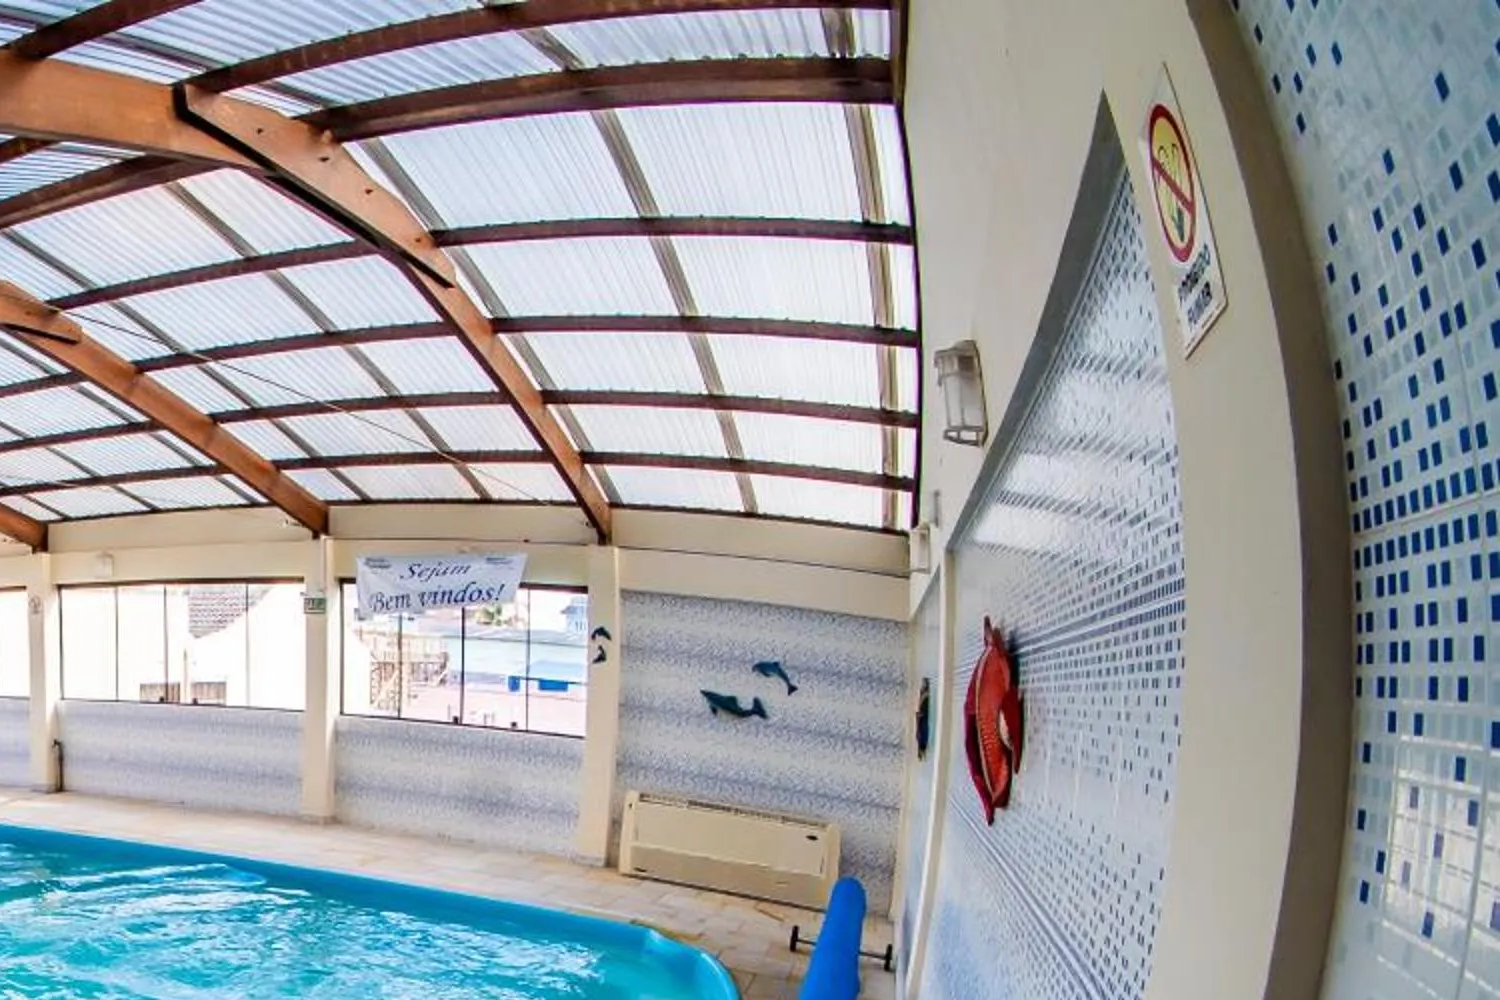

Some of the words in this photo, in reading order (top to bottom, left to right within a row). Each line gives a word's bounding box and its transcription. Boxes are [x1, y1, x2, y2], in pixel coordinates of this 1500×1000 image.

[400, 561, 472, 582] Sejam
[370, 591, 412, 613] Bem
[417, 581, 506, 608] vindos!
